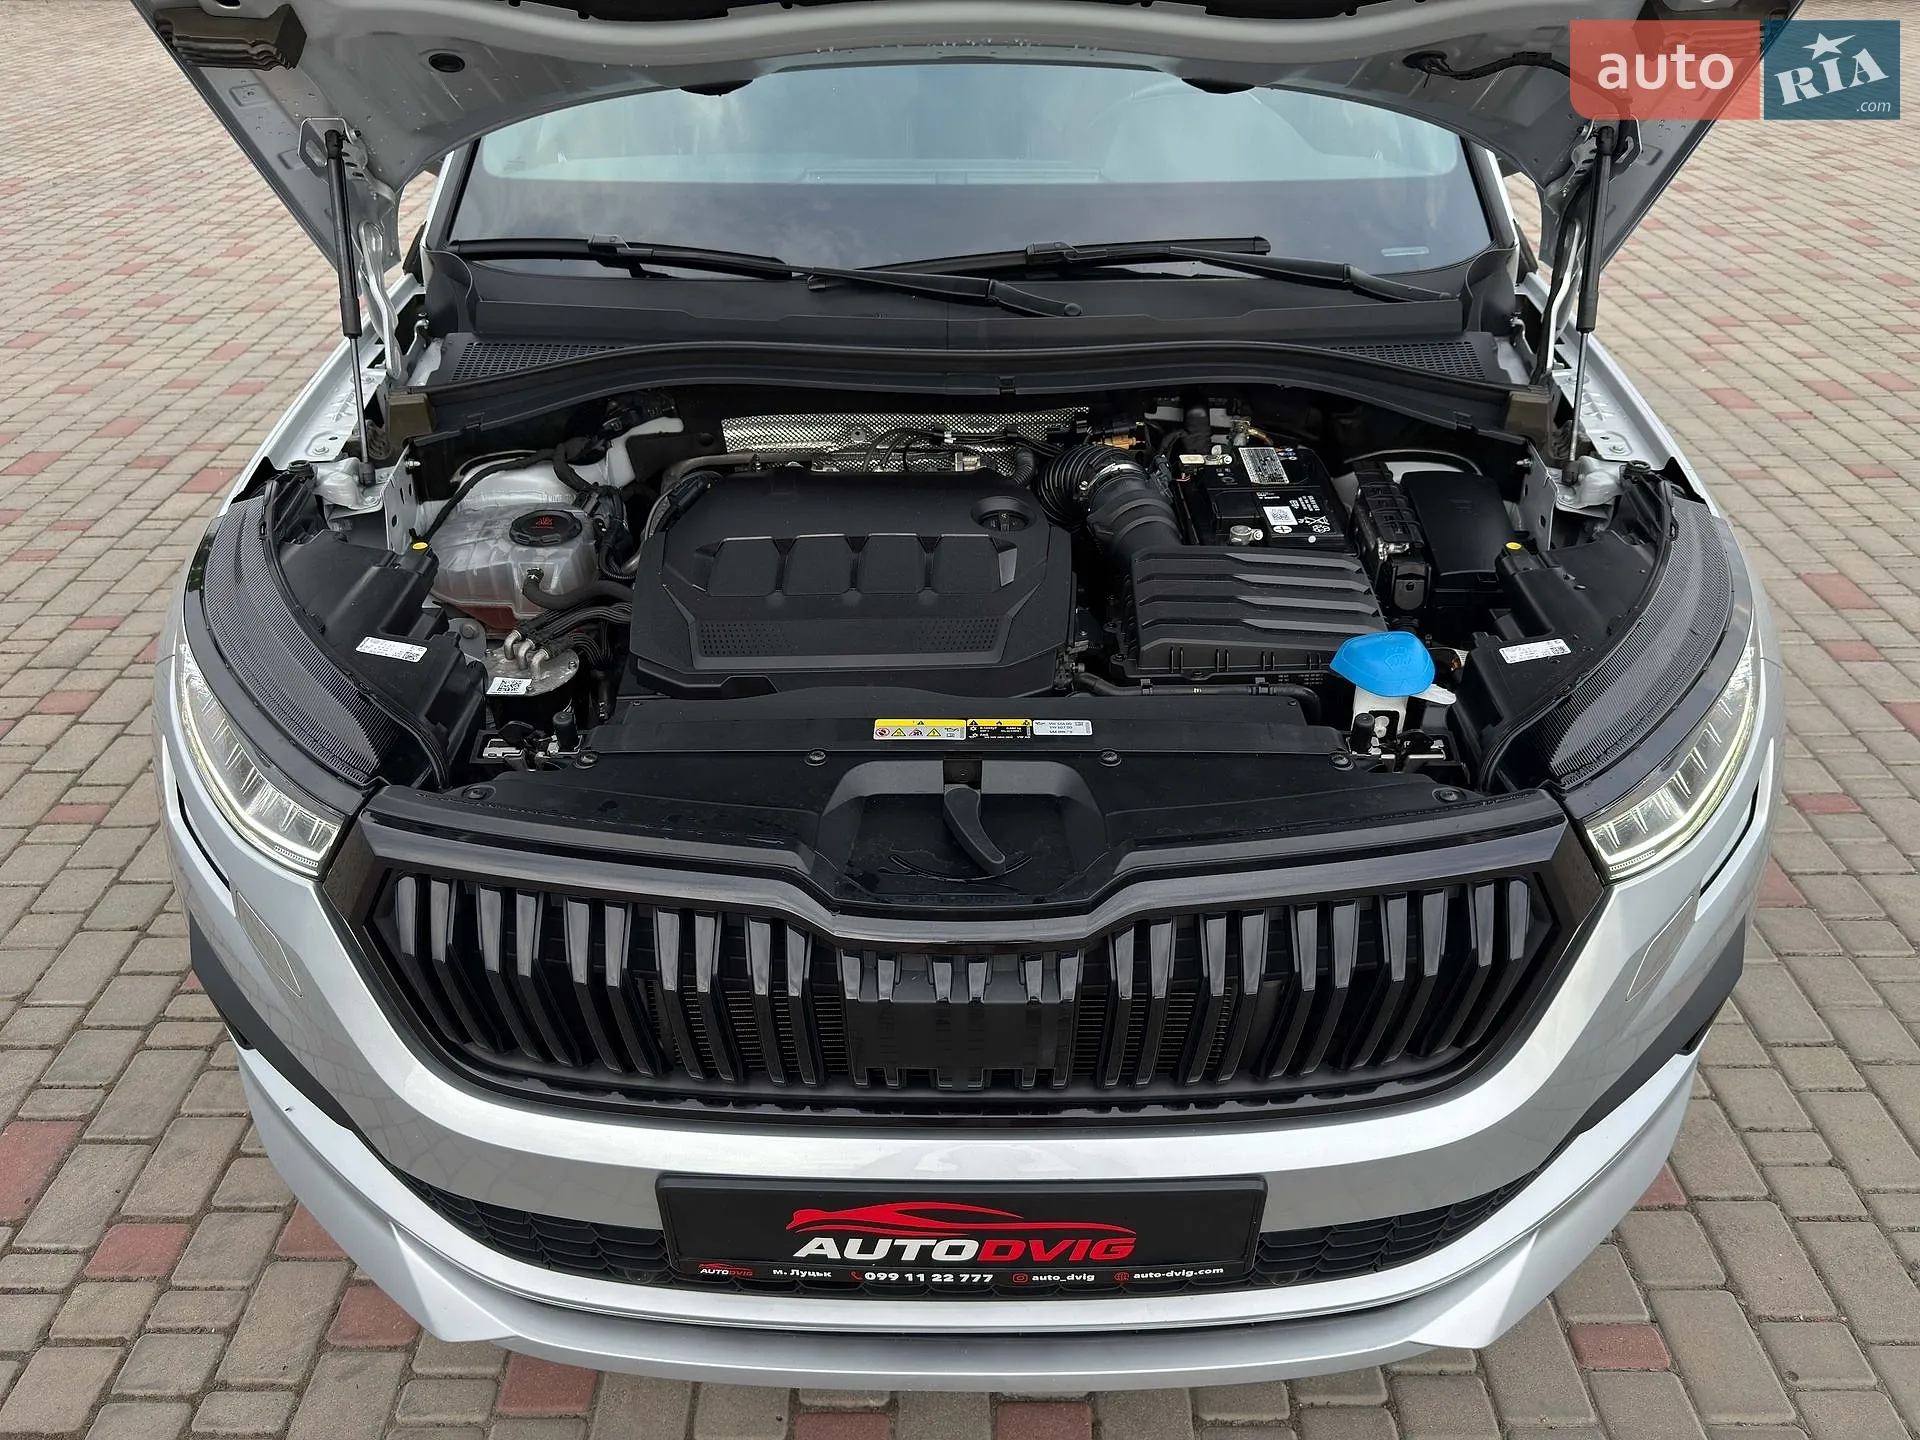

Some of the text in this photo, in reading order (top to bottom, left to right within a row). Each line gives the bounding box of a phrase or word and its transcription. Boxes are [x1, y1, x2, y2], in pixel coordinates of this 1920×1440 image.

[793, 1237, 1137, 1262] AUTODVIG
[700, 1268, 753, 1277] AUTODVIG
[790, 1268, 832, 1278] Луцьк
[864, 1271, 994, 1283] 099 11 22 777
[1032, 1272, 1095, 1283] auto_dvig
[1133, 1267, 1224, 1280] auto-dvig.com
